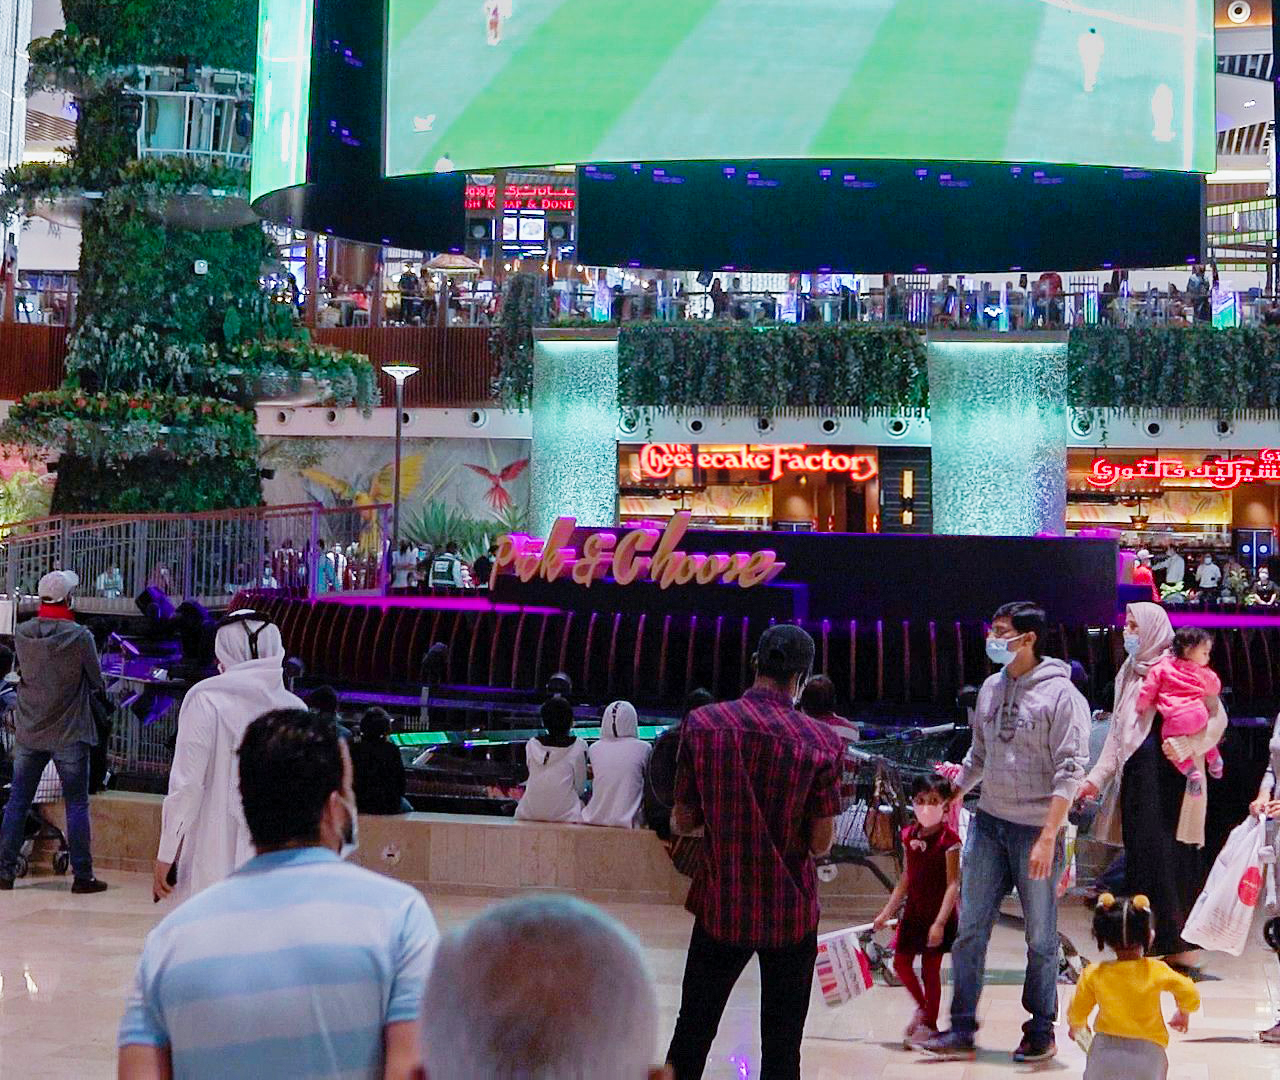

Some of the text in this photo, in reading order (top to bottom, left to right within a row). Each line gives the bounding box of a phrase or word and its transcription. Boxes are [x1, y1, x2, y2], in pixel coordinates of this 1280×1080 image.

[541, 200, 575, 209] DONE
[762, 443, 877, 482] Factory
[613, 510, 786, 590] Choose
